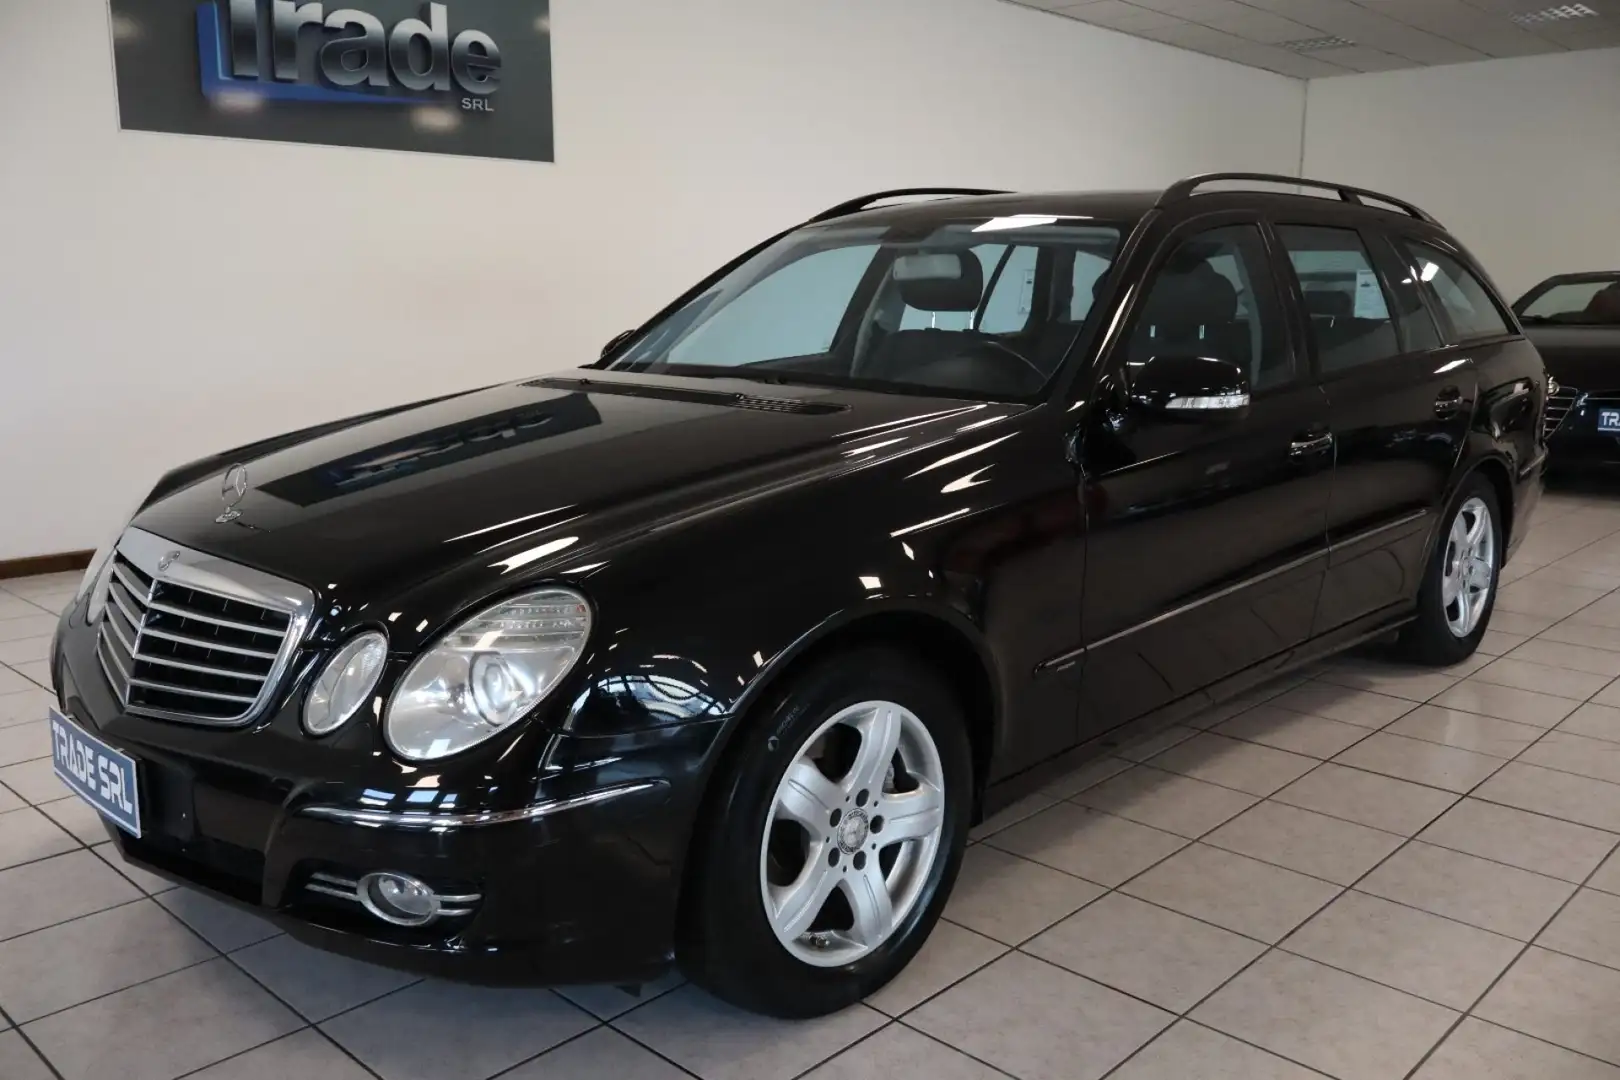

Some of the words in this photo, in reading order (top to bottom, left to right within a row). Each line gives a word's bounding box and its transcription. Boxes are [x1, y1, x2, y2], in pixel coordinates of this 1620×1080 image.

[461, 97, 495, 112] SRL
[1602, 411, 1620, 427] TR
[52, 719, 96, 791] TRADE
[98, 755, 133, 814] SRL
